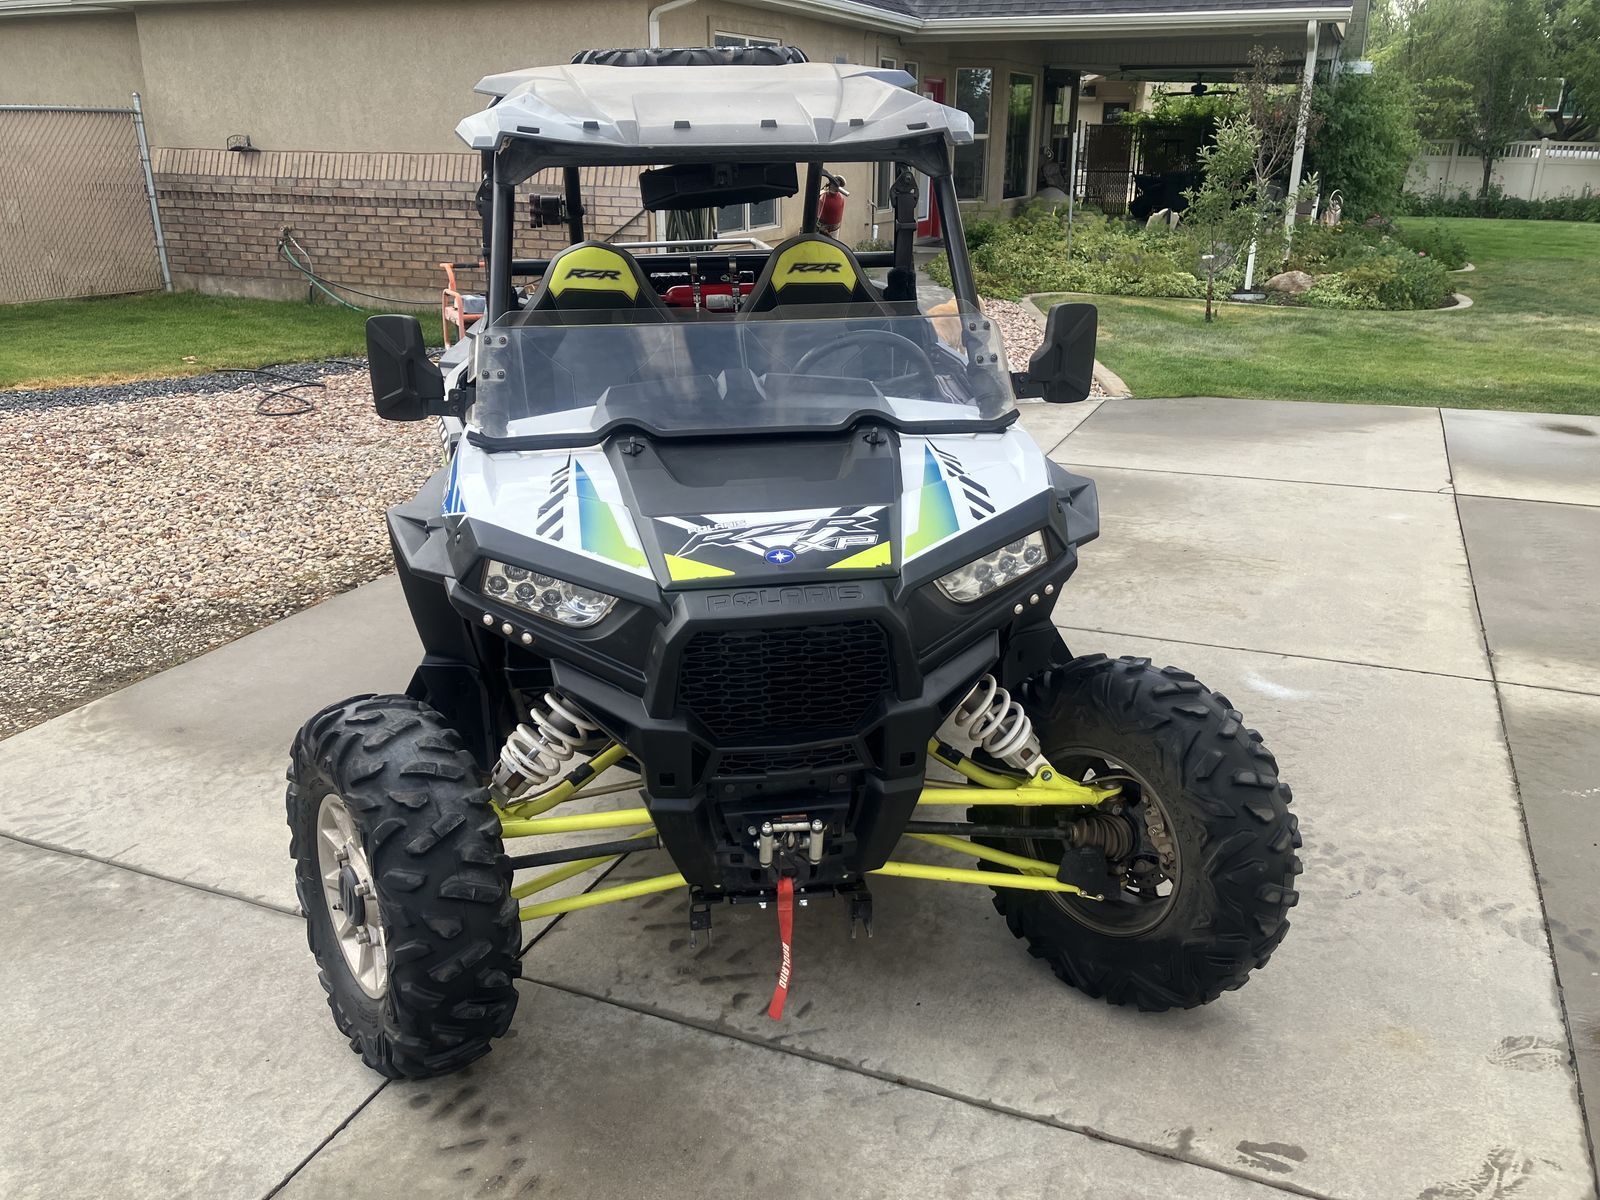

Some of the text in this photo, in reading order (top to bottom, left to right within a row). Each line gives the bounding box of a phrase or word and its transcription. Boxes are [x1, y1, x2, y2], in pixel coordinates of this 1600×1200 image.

[565, 269, 621, 280] RZR
[788, 263, 842, 274] RZR
[793, 534, 878, 554] XP
[706, 586, 865, 612] POLARIS
[779, 942, 790, 989] BADLAND
